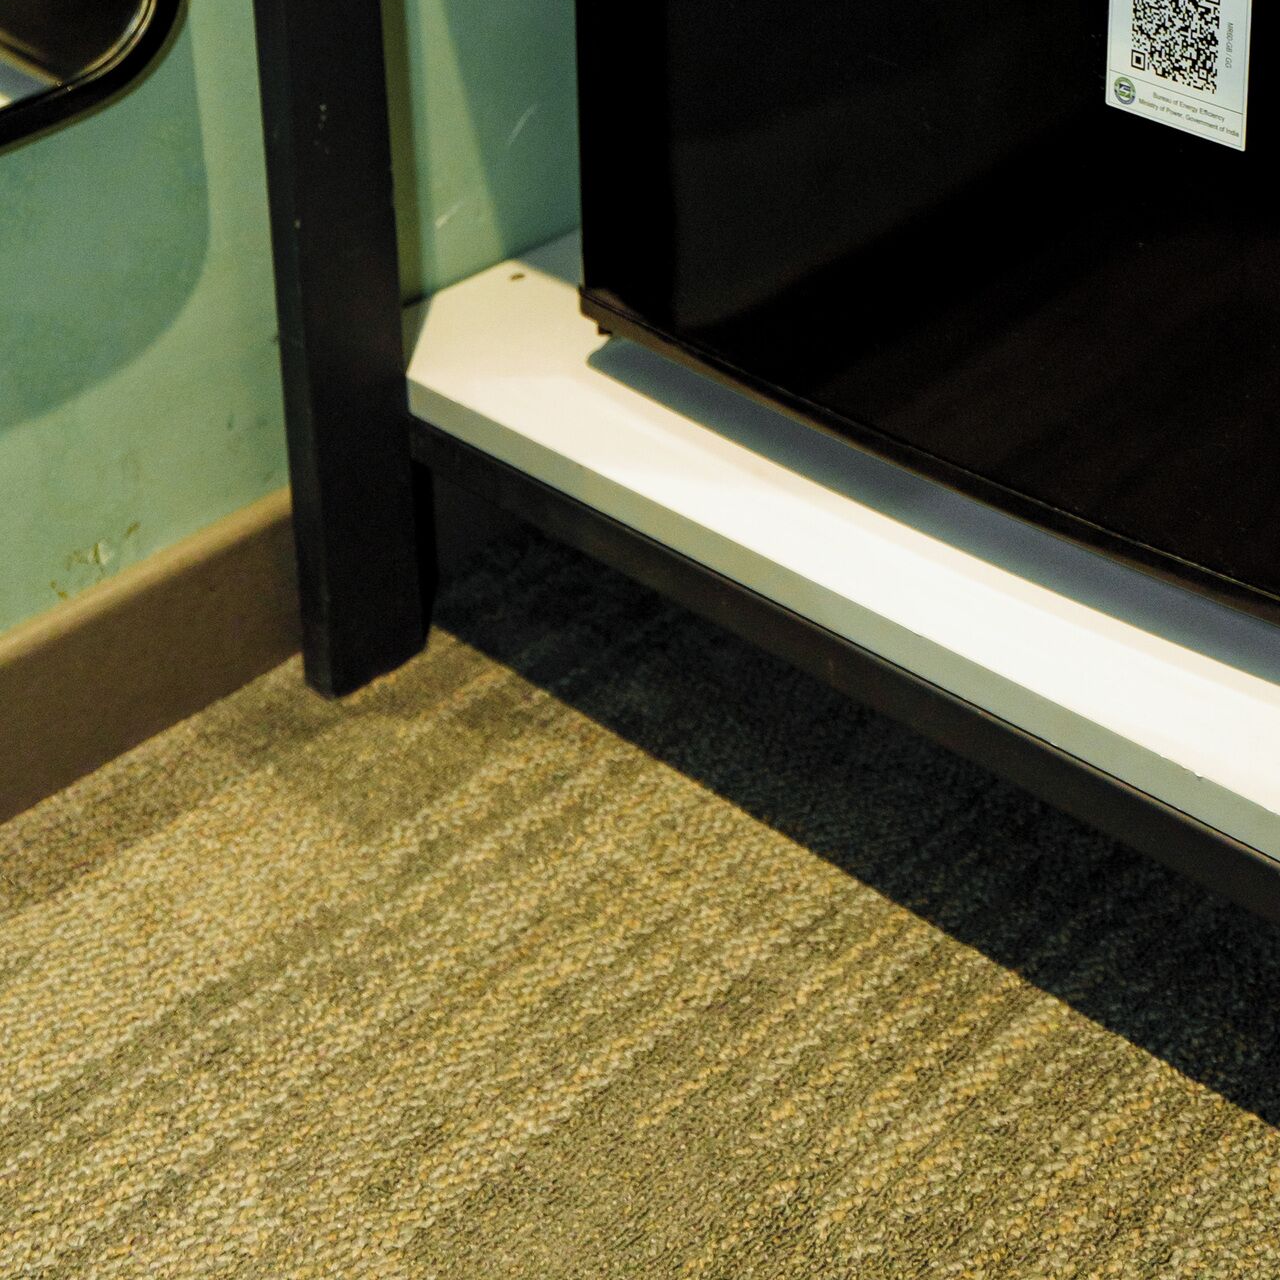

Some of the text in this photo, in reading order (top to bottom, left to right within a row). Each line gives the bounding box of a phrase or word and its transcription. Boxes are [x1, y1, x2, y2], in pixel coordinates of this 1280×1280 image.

[1138, 98, 1158, 111] Ministry
[1159, 104, 1166, 112] of
[1185, 114, 1218, 130] Government
[1226, 127, 1240, 138] India
[1180, 100, 1199, 113] Energy
[1200, 107, 1225, 122] Efficiency
